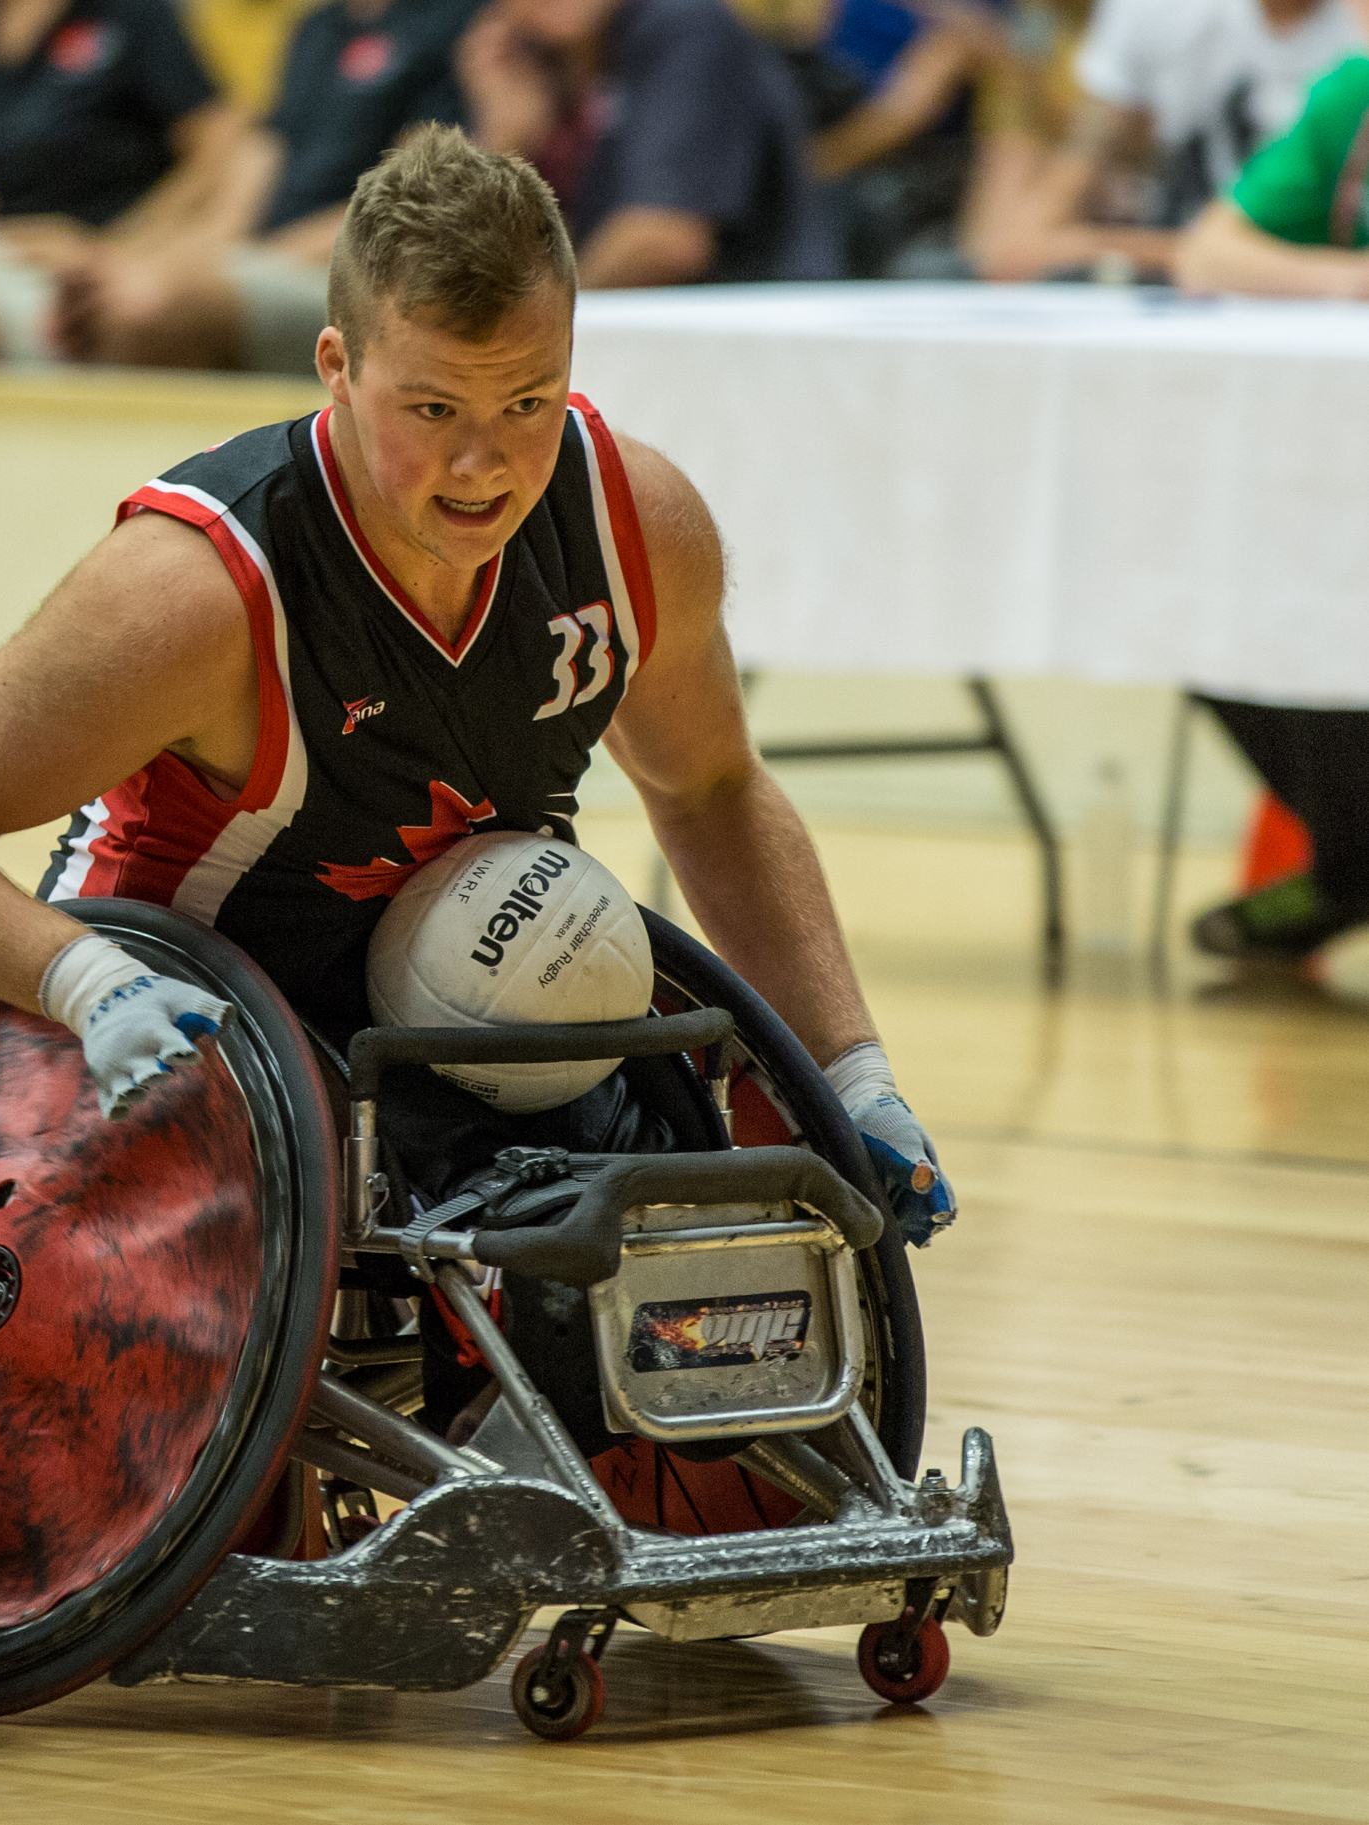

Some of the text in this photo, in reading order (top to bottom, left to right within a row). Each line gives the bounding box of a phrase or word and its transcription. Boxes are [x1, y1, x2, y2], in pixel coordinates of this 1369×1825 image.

[532, 600, 614, 721] 33
[470, 849, 571, 968] molten
[538, 895, 611, 989] Wheelchair Rugby
[441, 1073, 499, 1095] EELCHAIR
